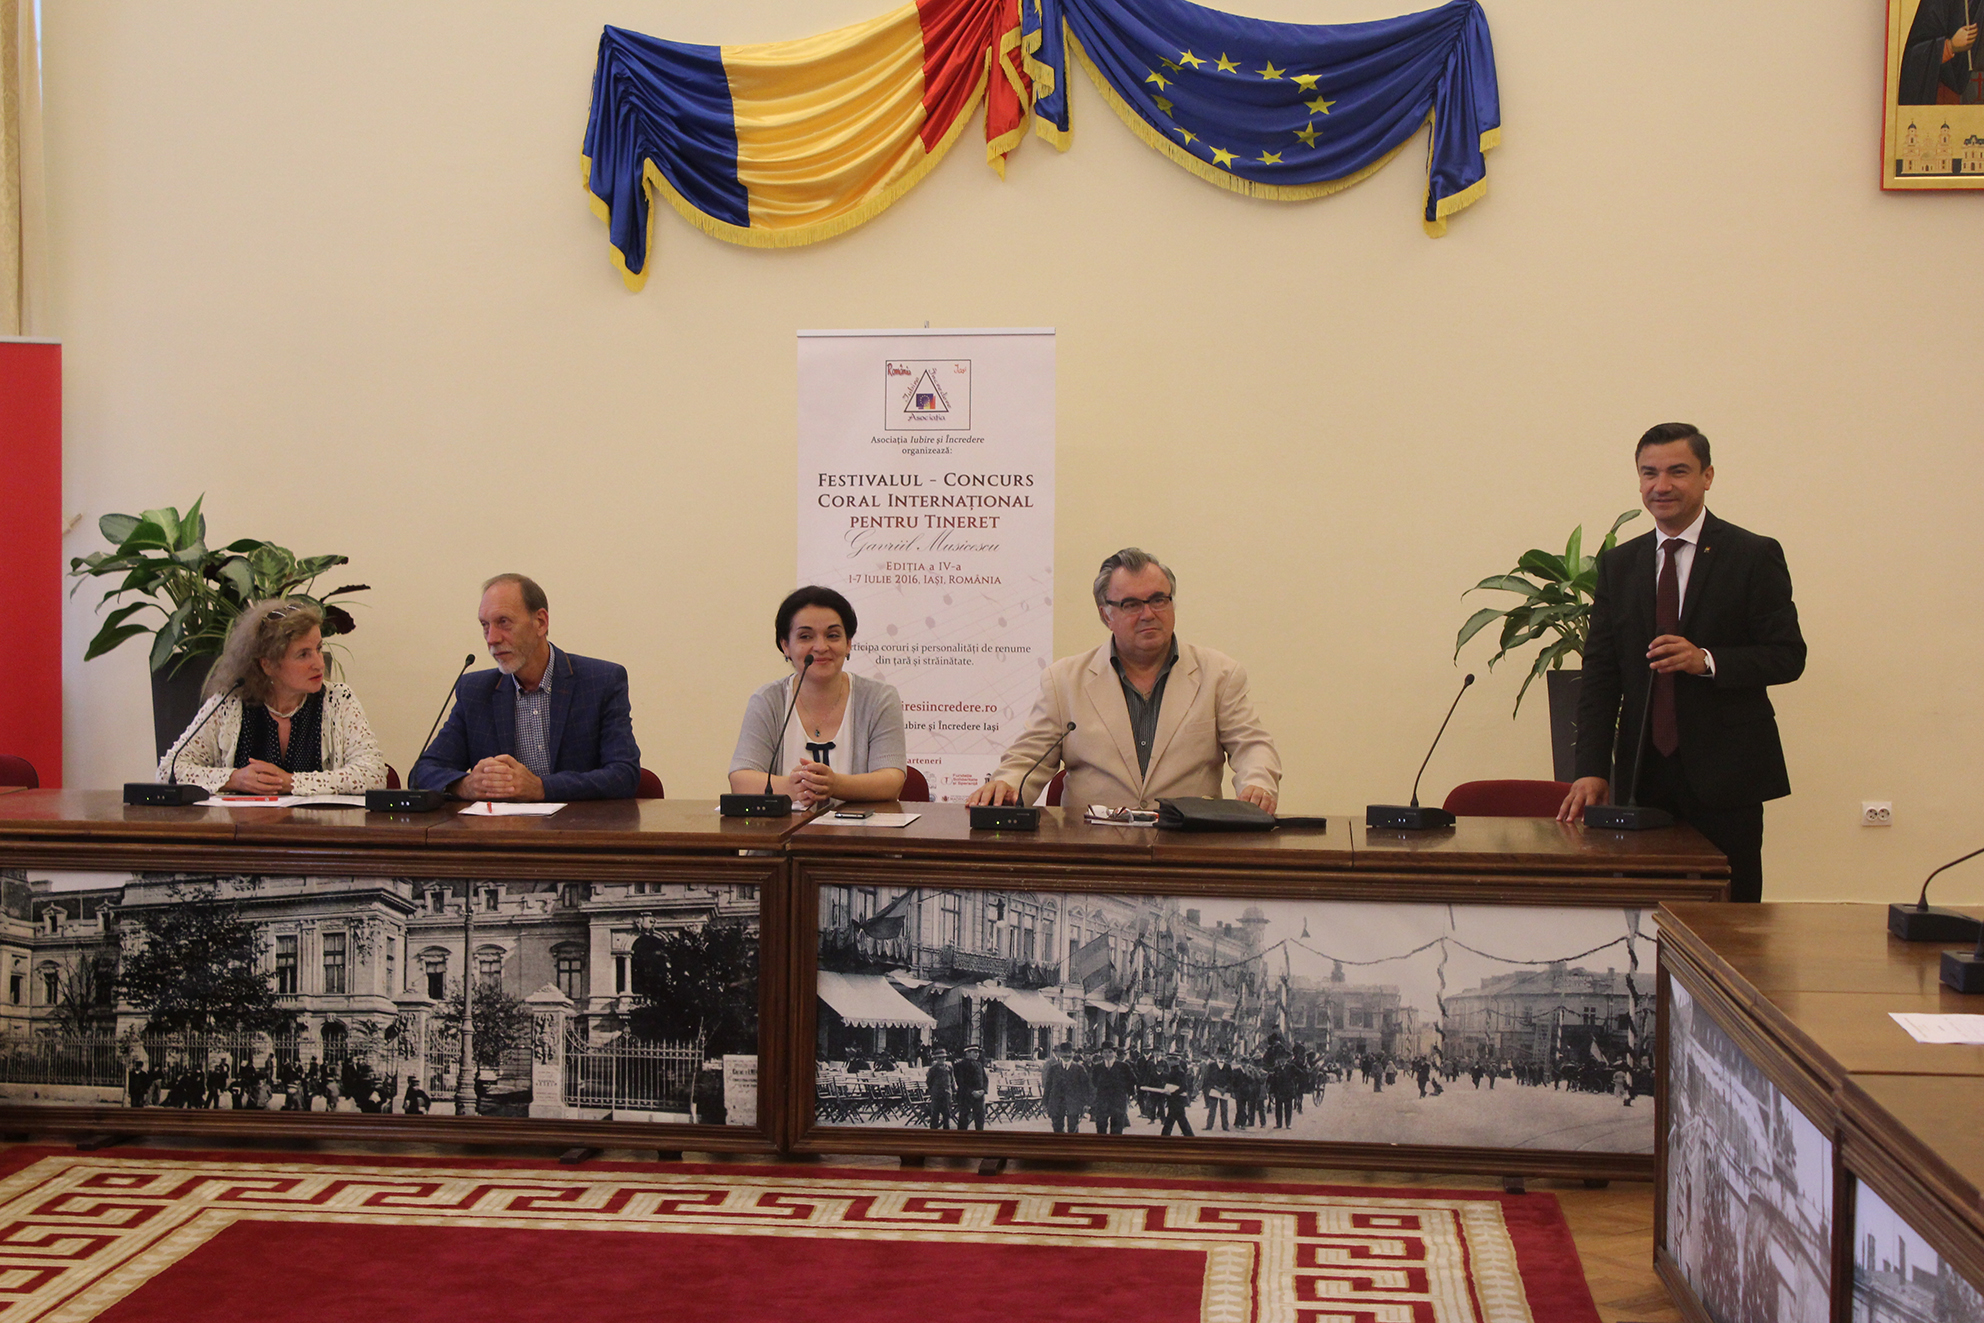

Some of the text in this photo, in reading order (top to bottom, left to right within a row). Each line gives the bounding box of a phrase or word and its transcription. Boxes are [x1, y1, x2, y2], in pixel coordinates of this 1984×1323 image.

[870, 434, 985, 445] Asociația Iubire și Încredere
[902, 446, 953, 456] organizează:
[818, 473, 923, 487] FESTIVALUL
[944, 472, 1034, 487] CONCURS
[818, 494, 1034, 510] CORAL INTERNAȚIONAL
[850, 514, 1000, 528] PENTRU TINERET
[844, 528, 1002, 558] Gavriil Musicescu
[886, 562, 925, 572] EDIȚIA
[938, 562, 962, 571] IV-a
[848, 575, 862, 584] 1-7
[864, 575, 892, 584] IULIE
[895, 575, 921, 585] 2016,
[949, 574, 1002, 584] ROMÂNIA
[881, 643, 909, 652] coruri
[911, 643, 919, 653] și
[921, 643, 979, 654] personalități
[981, 644, 993, 652] de
[875, 656, 974, 666] din țară și străinătate.
[902, 701, 998, 712] iresiincredere.ro
[928, 722, 936, 732] și
[938, 720, 981, 730] Încredere
[984, 722, 999, 732] Iași
